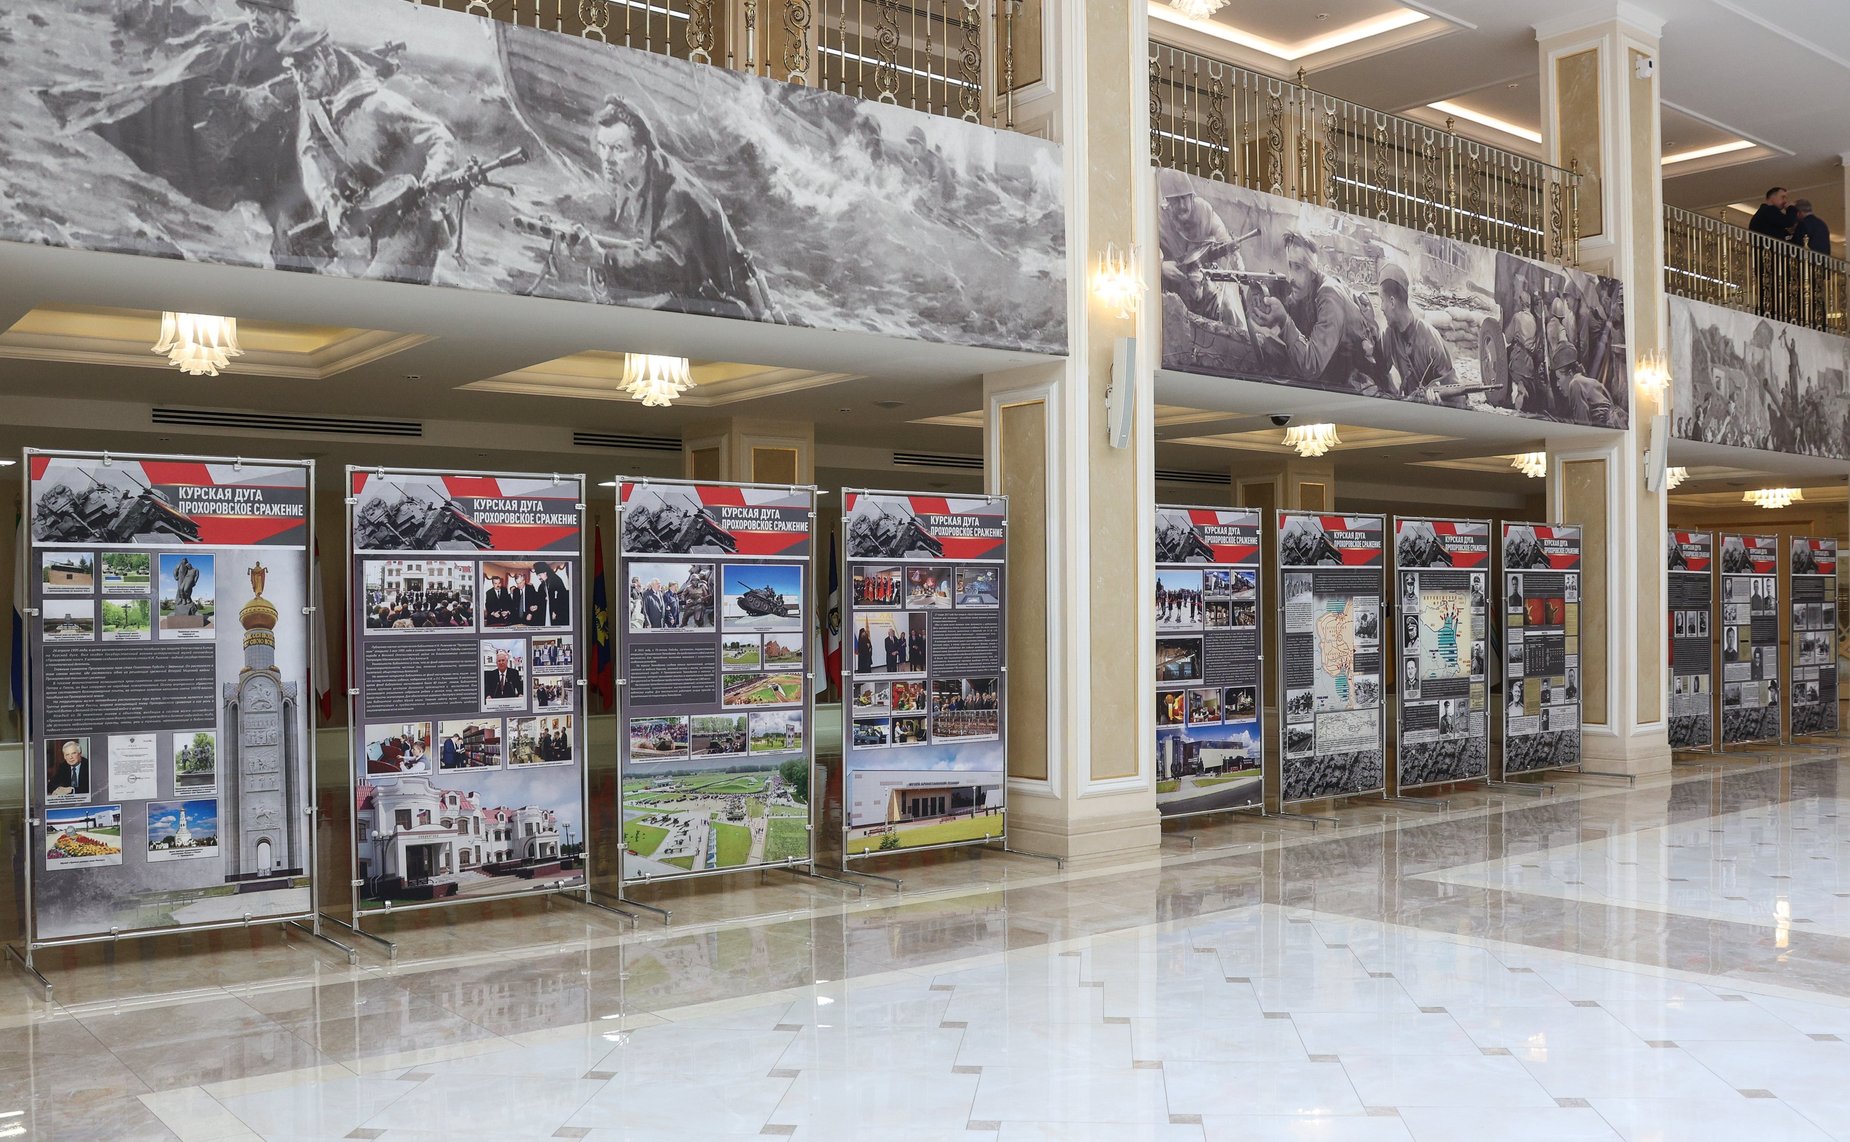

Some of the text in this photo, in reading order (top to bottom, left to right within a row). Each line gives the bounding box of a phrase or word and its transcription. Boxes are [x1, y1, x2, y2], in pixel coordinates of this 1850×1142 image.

[179, 487, 263, 502] КУРСКАЯ ДУГА
[179, 501, 303, 516] ПРОХОРОВСКОЕ СРАЖЕНИЕ
[474, 499, 543, 513] КУРСКАЯ ДУГА
[474, 512, 577, 525] ПРОХОРОВСКОЕ СРАЖЕНИЕ
[721, 507, 780, 520] КУРСКАЯ ДУГА
[721, 519, 808, 531] ПРОХОРОВСКОЕ СРАЖЕНИЕ
[930, 516, 979, 527] КУРСКАЯ ДУГА
[974, 528, 1003, 537] СРАЖЕНИЕ
